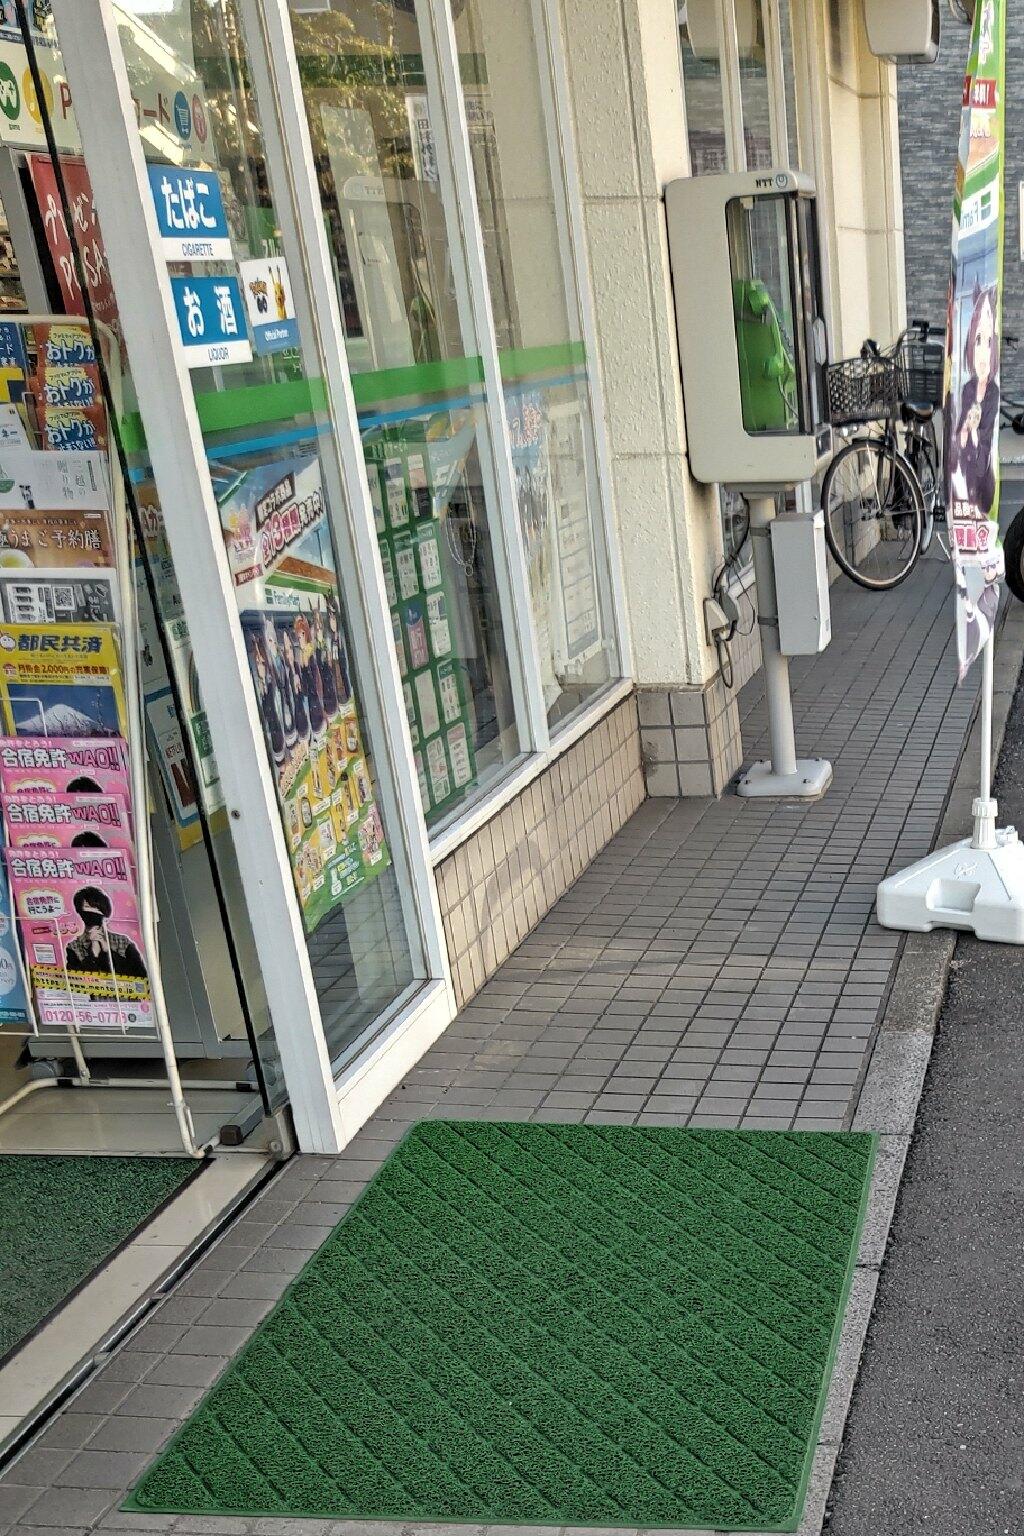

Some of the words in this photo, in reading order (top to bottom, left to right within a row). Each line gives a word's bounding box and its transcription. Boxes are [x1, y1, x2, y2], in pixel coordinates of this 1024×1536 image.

[755, 178, 773, 188] NTT
[161, 176, 217, 230] たばこ
[181, 243, 214, 257] CIGARETTE
[183, 285, 239, 337] お酒
[207, 346, 230, 361] LIQUOR
[18, 634, 102, 652] 都民共済
